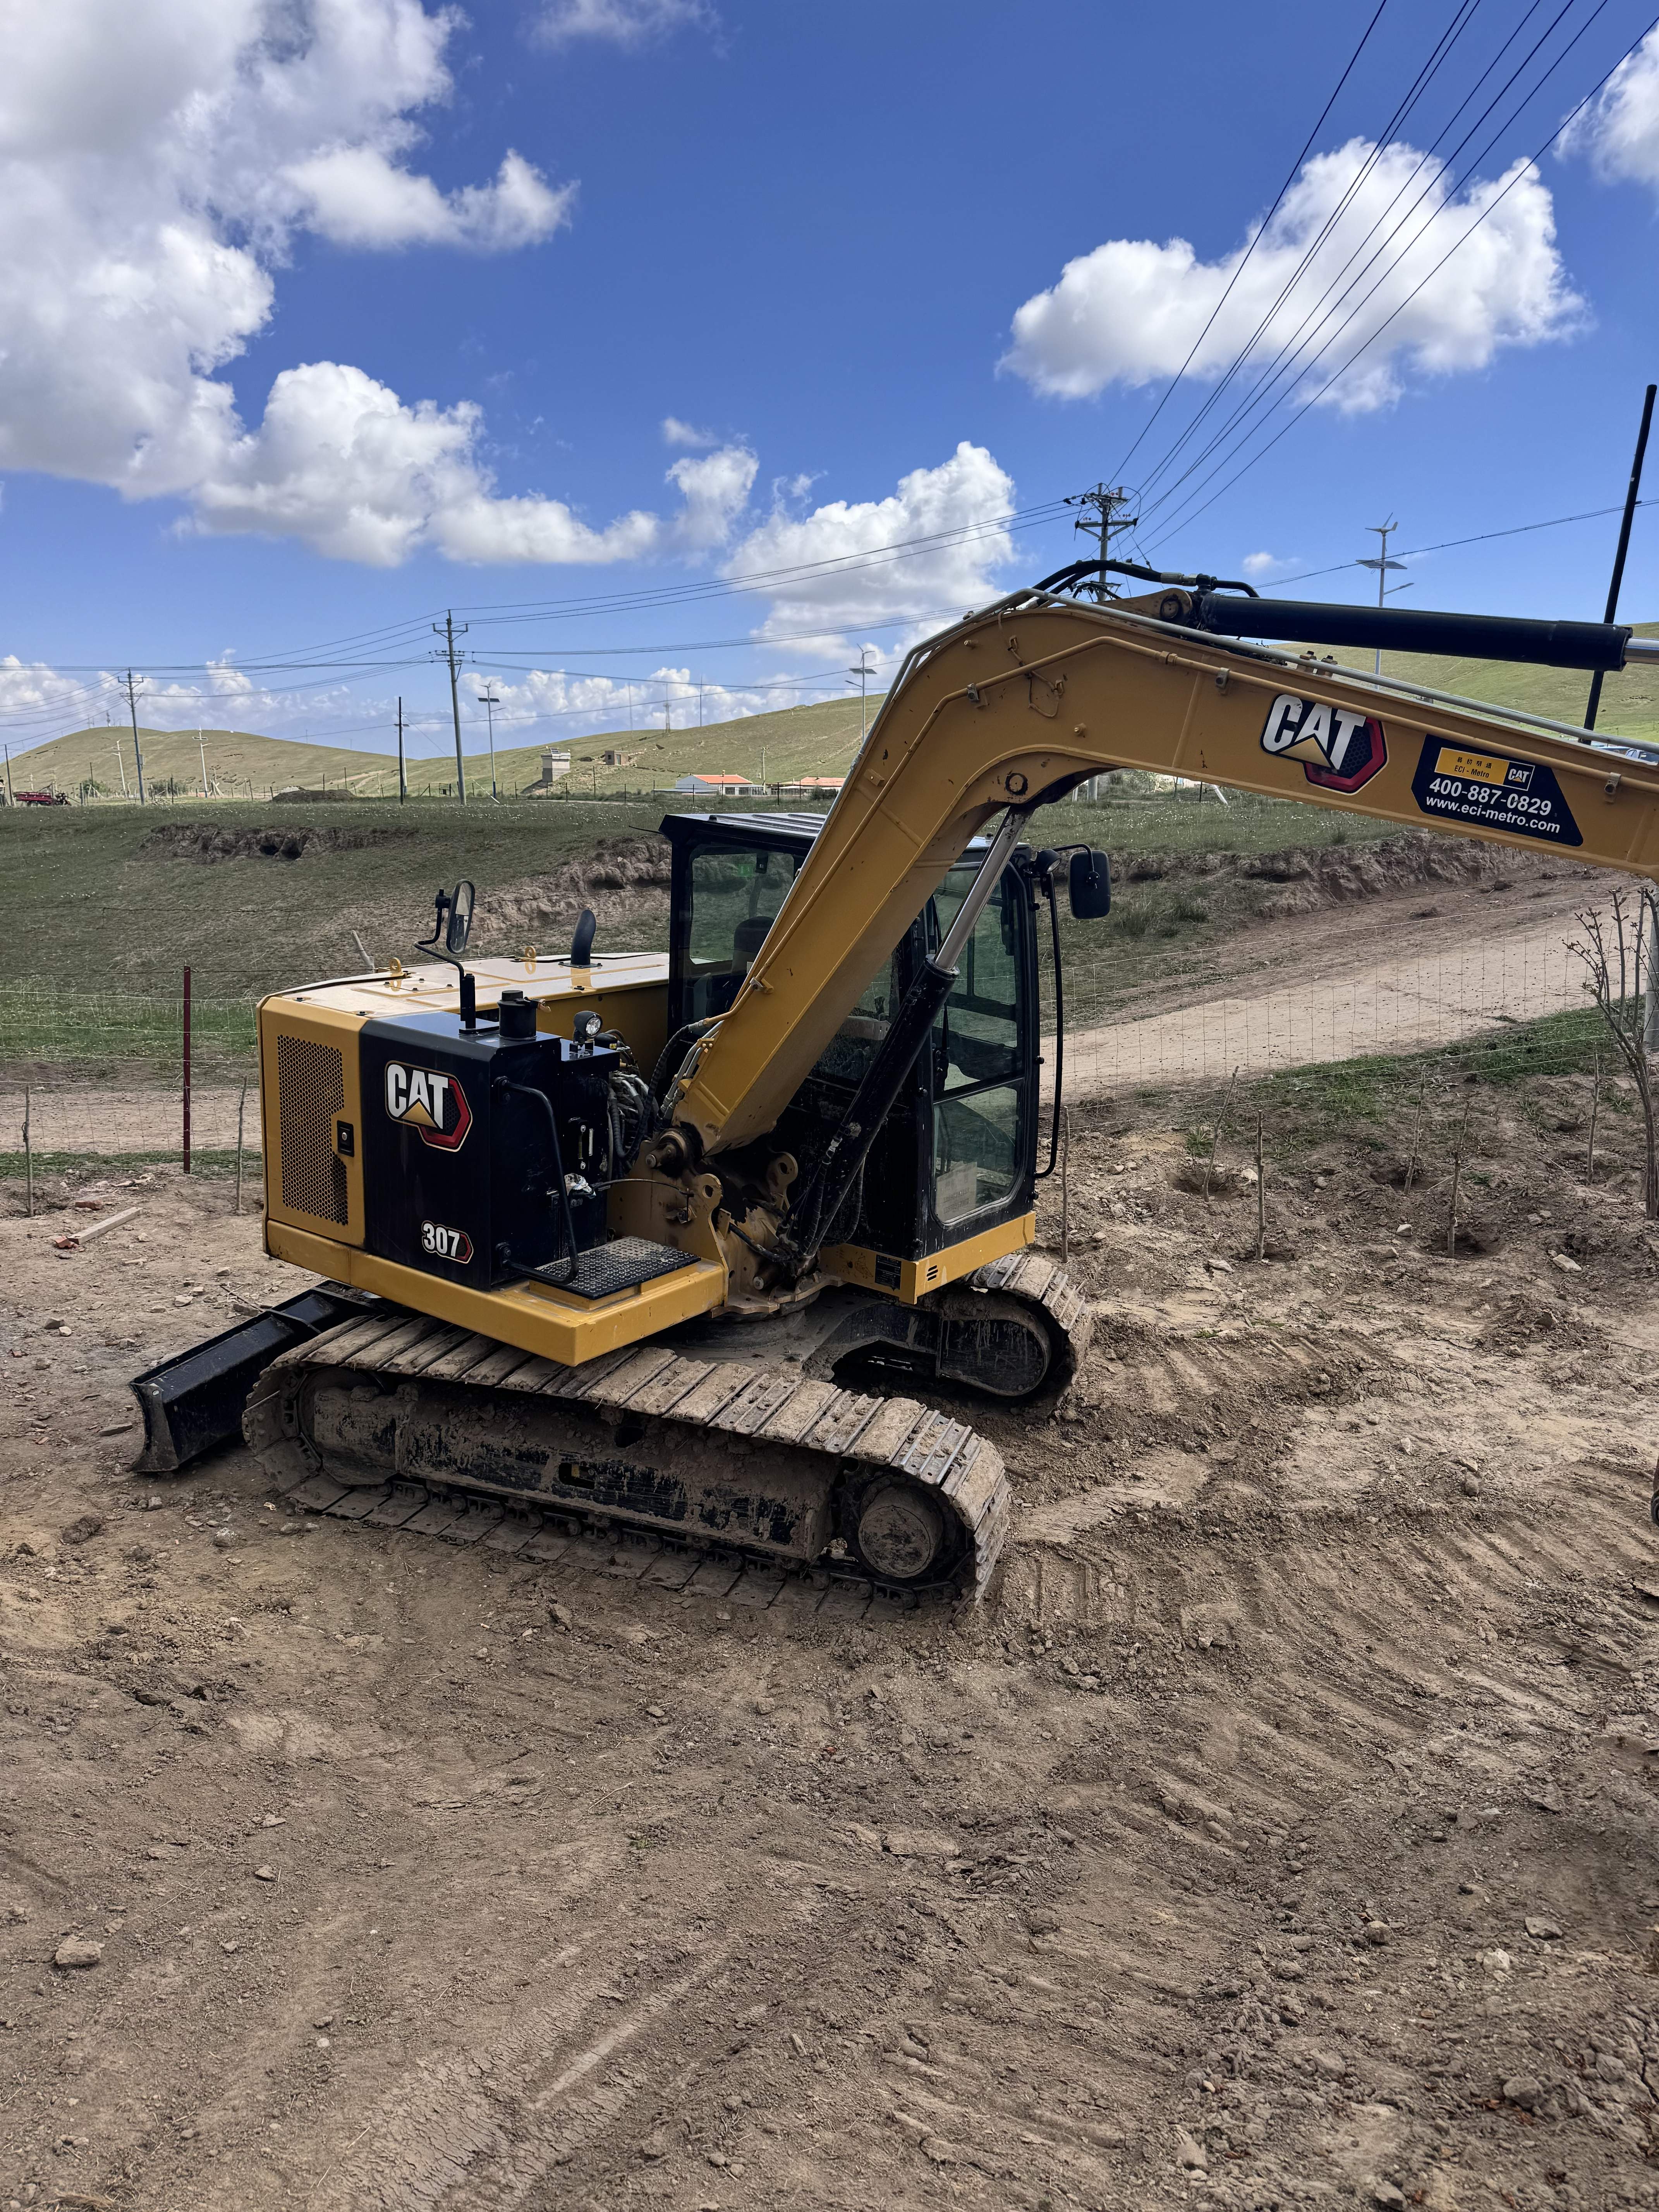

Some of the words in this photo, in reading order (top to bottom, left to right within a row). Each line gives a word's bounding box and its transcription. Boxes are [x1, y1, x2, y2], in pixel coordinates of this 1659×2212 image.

[1263, 694, 1366, 770] CAT
[1455, 765, 1465, 773] ECI
[1508, 768, 1529, 783] CAT
[1426, 797, 1560, 833] www.eci-metro.com
[1429, 778, 1552, 816] 400-887-0829
[387, 1064, 448, 1129] CAT
[423, 1223, 460, 1257] 307
